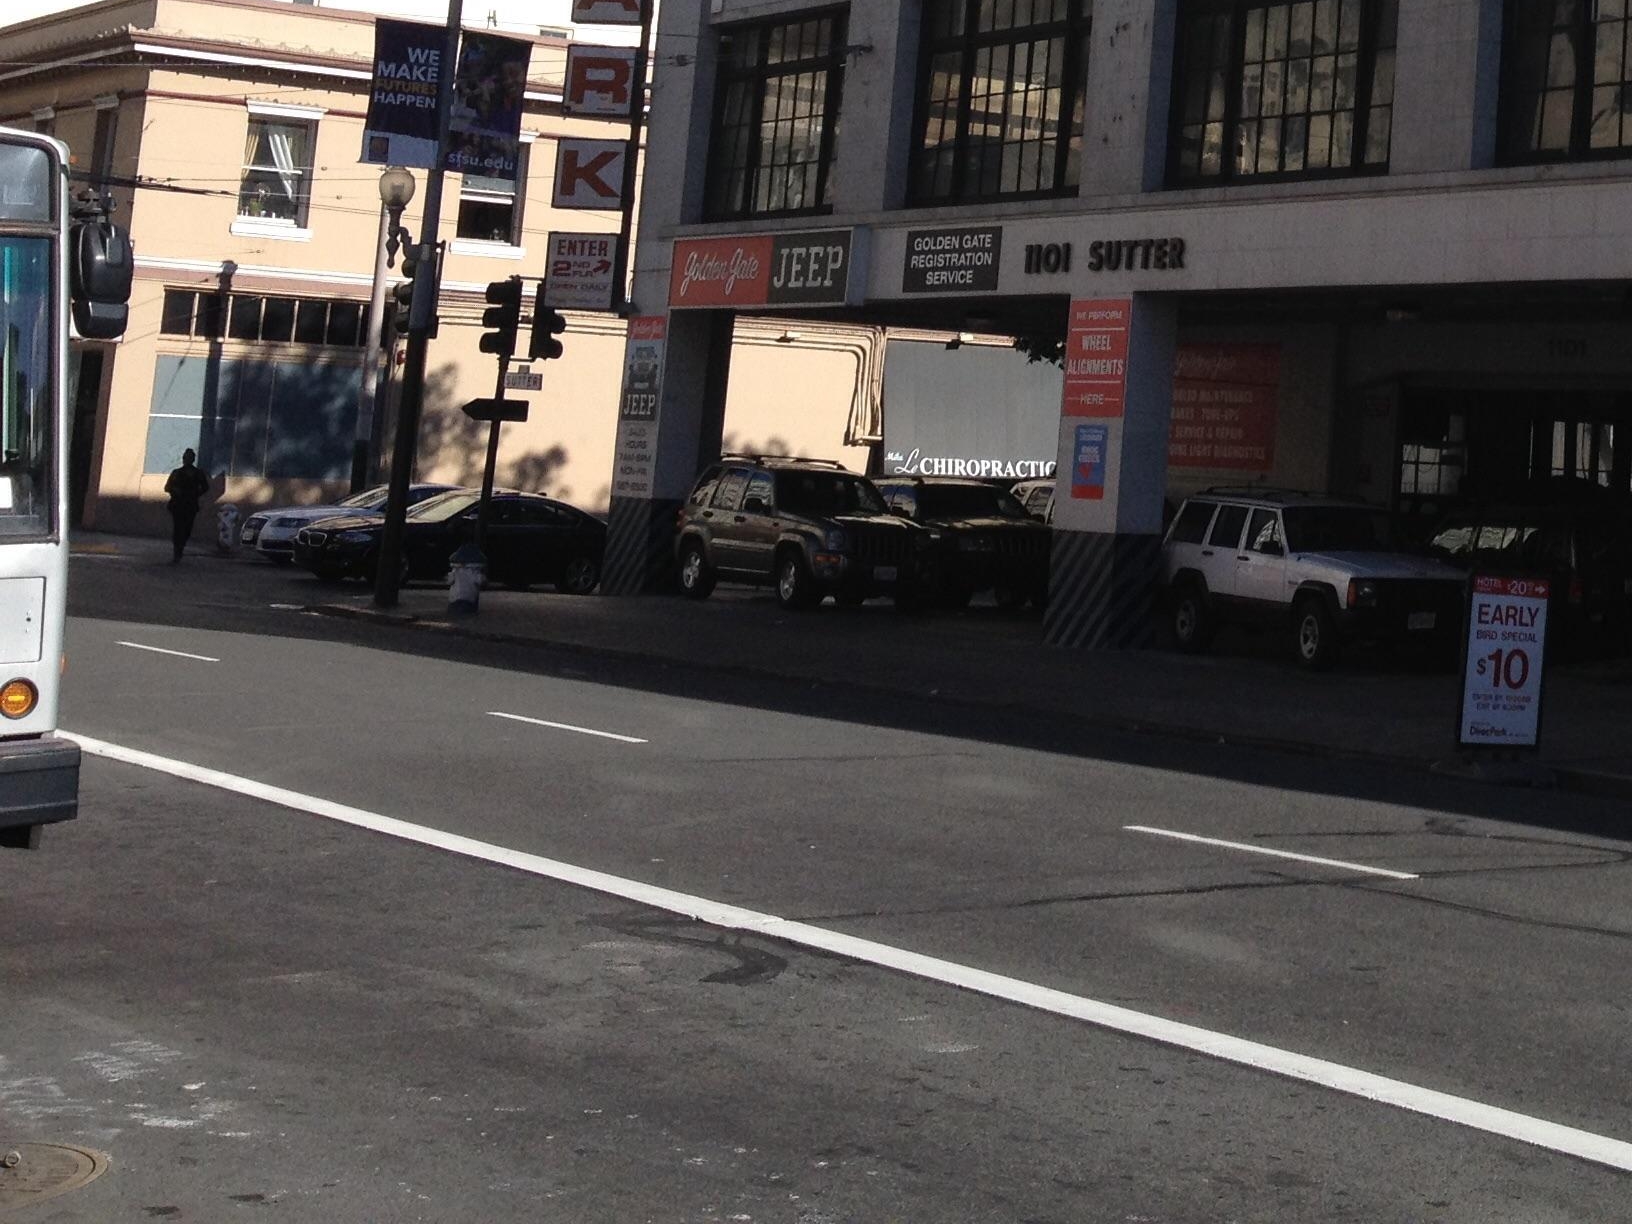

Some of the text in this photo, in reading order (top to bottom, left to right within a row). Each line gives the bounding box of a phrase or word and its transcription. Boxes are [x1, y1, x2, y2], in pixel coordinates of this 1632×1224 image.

[407, 47, 441, 66] WE
[377, 60, 439, 83] MAKE
[374, 78, 438, 96] FUTURES
[374, 91, 437, 109] HAPPEN
[449, 149, 514, 170] sfsu.edu
[557, 239, 608, 256] ENTER
[914, 233, 993, 252] GOLDEN GATE
[911, 251, 993, 268] REGISTRATION
[1088, 237, 1185, 272] SUTTER
[552, 260, 572, 277] 2
[680, 245, 844, 297] Golden Gate JEEP
[925, 269, 974, 285] SERVICE
[1082, 335, 1112, 351] WHEEL
[1067, 359, 1123, 376] ALIGNMENTS
[624, 393, 656, 416] JEEP
[1080, 393, 1104, 405] HERE
[919, 457, 1057, 478] CHIROPRACTIC
[1477, 603, 1540, 627] EARLY
[1476, 630, 1538, 643] BIRD SPECIAL
[1476, 648, 1530, 690] $10
